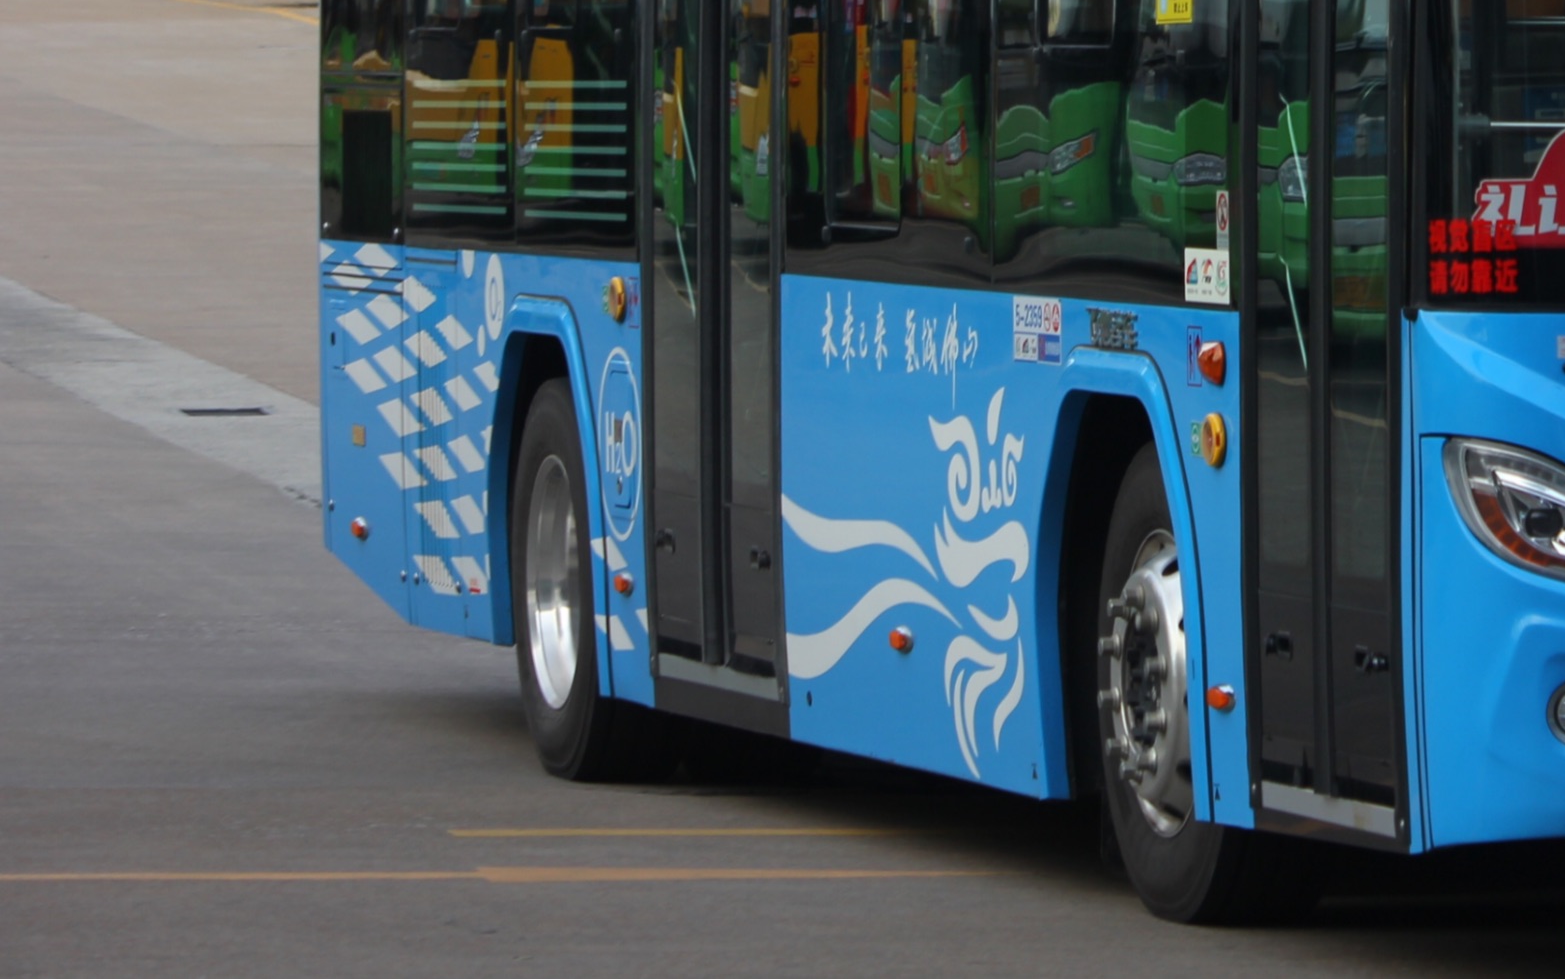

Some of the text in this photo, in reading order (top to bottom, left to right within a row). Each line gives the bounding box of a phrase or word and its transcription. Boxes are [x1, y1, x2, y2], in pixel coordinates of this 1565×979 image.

[1429, 219, 1517, 254] 视觉盲区
[1429, 259, 1520, 295] 请勿靠近
[1015, 303, 1043, 328] 5-2359
